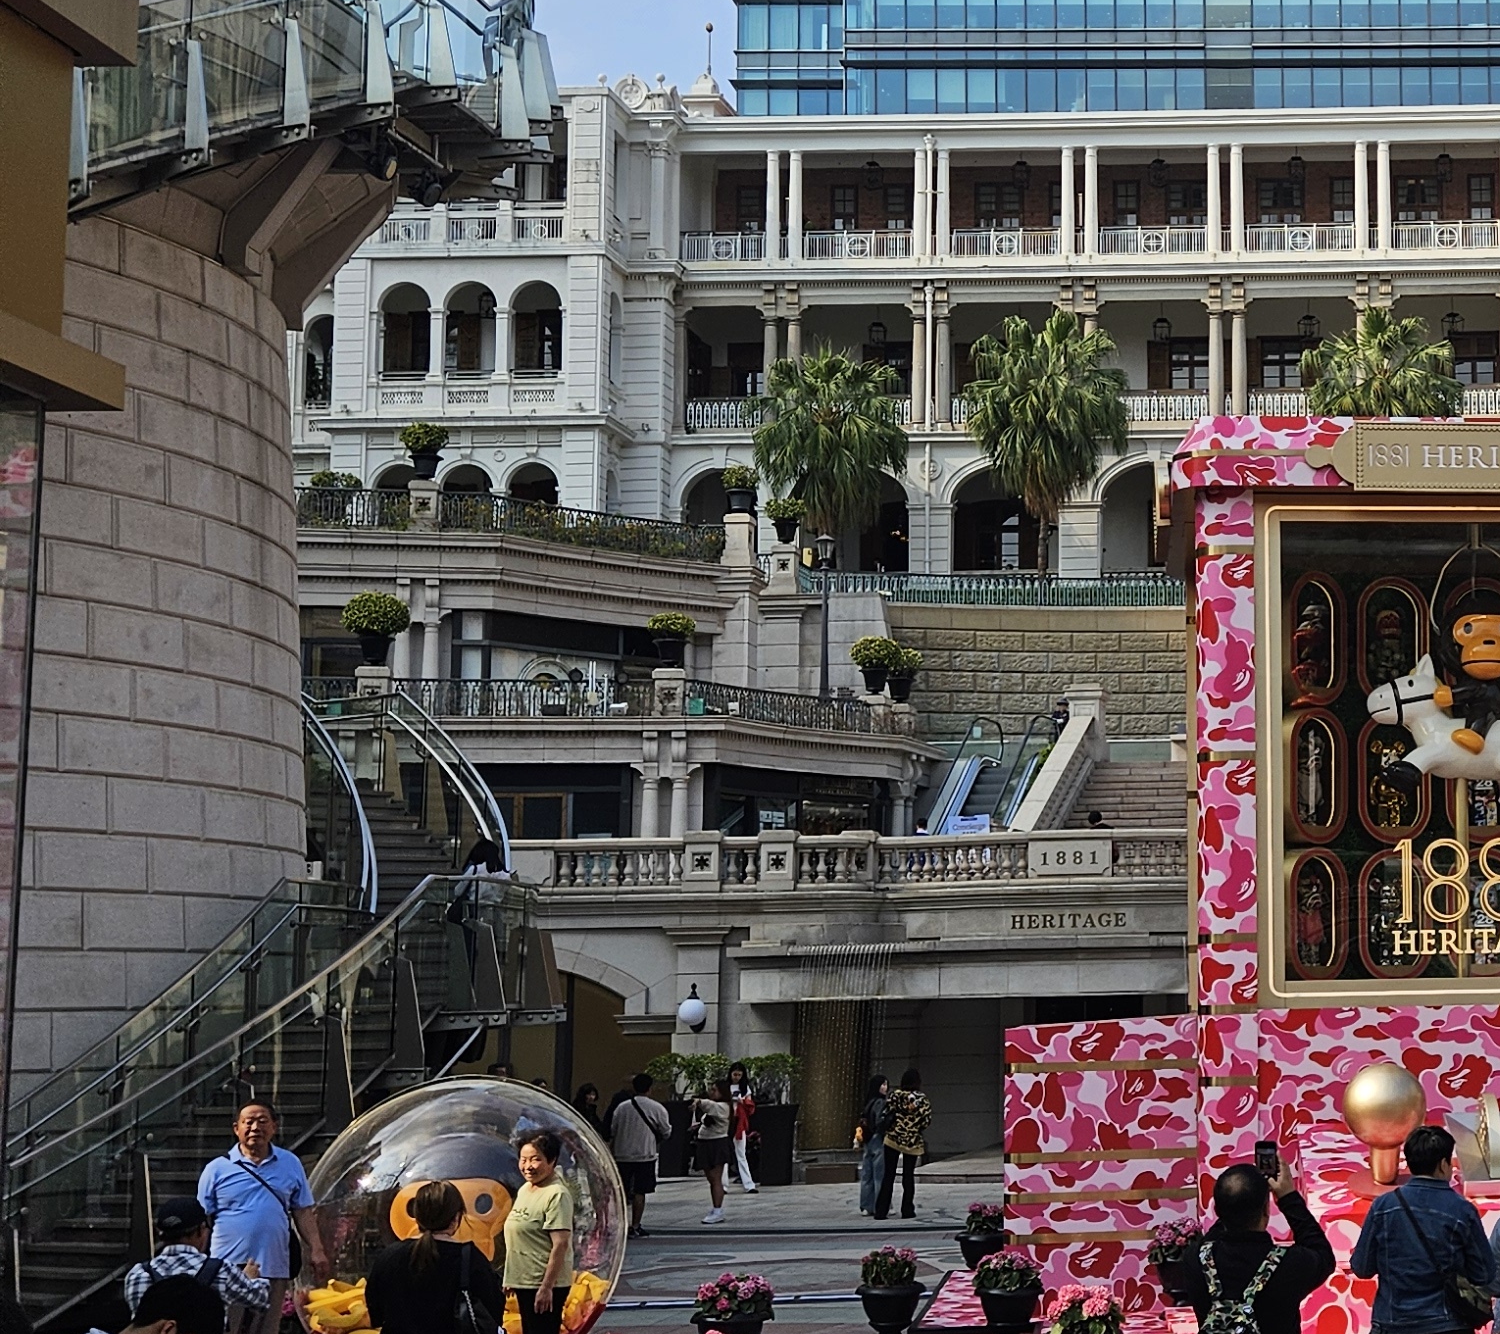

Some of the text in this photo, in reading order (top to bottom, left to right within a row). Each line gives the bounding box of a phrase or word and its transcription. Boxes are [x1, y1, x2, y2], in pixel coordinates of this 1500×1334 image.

[1367, 443, 1410, 468] 1881
[1040, 850, 1099, 866] 1881
[1011, 912, 1127, 930] HERITAGE
